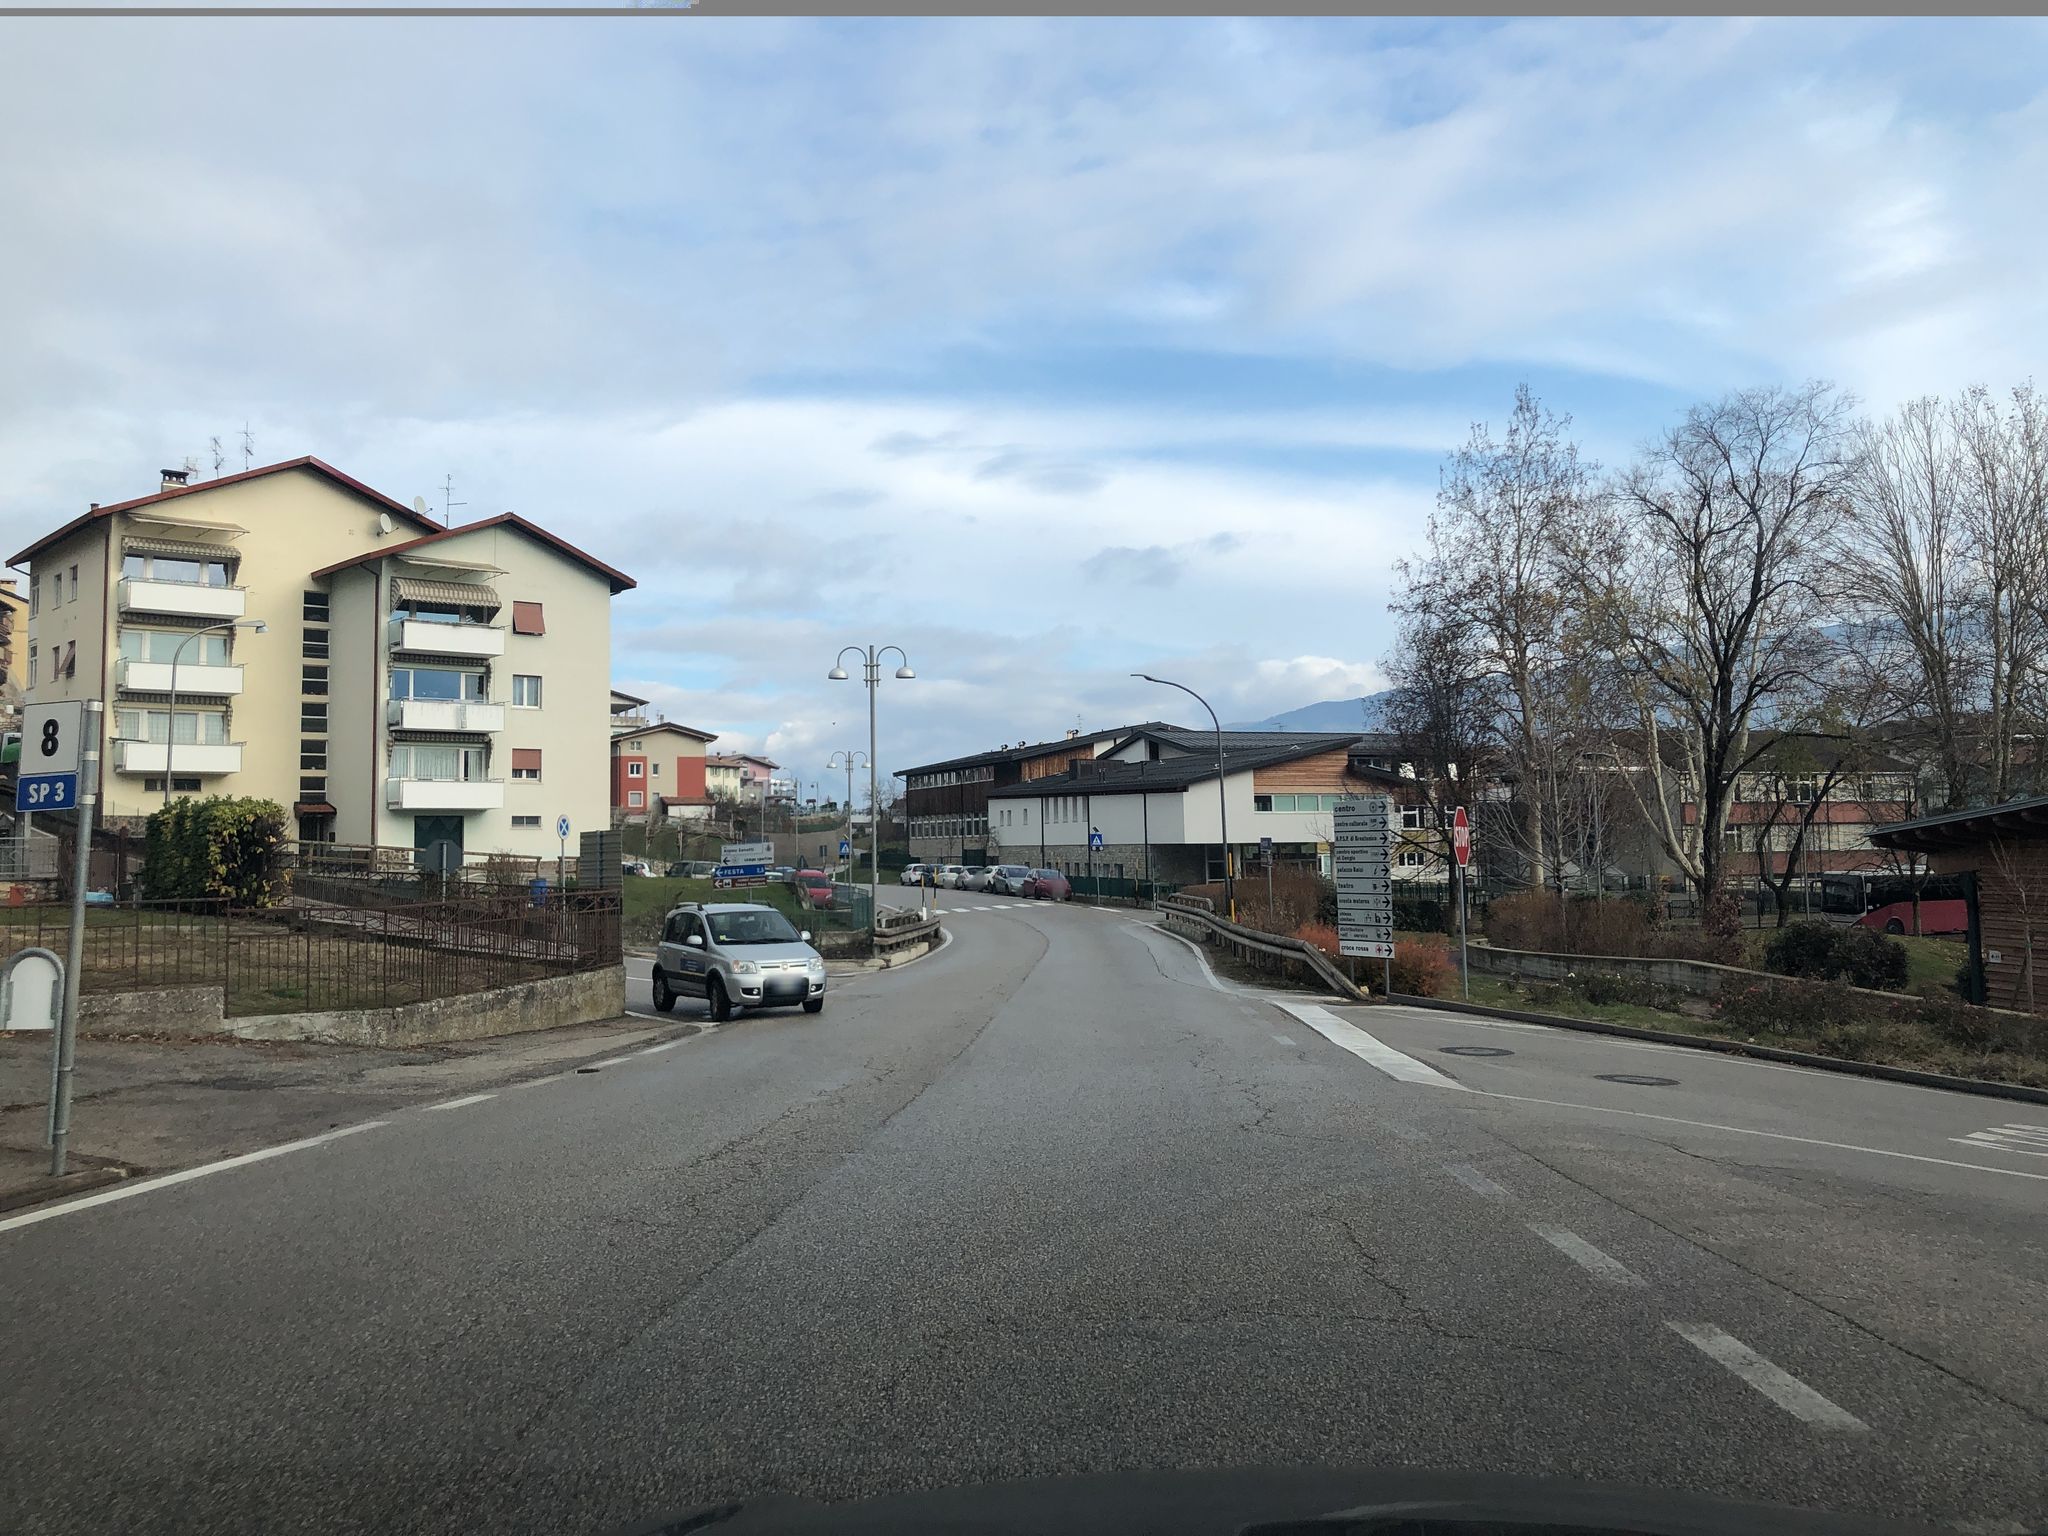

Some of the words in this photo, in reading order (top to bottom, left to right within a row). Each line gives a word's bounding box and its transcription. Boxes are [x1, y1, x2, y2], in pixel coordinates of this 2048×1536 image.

[41, 718, 59, 757] 8
[28, 783, 50, 804] SP
[54, 781, 65, 802] 3
[1455, 826, 1468, 848] STOP
